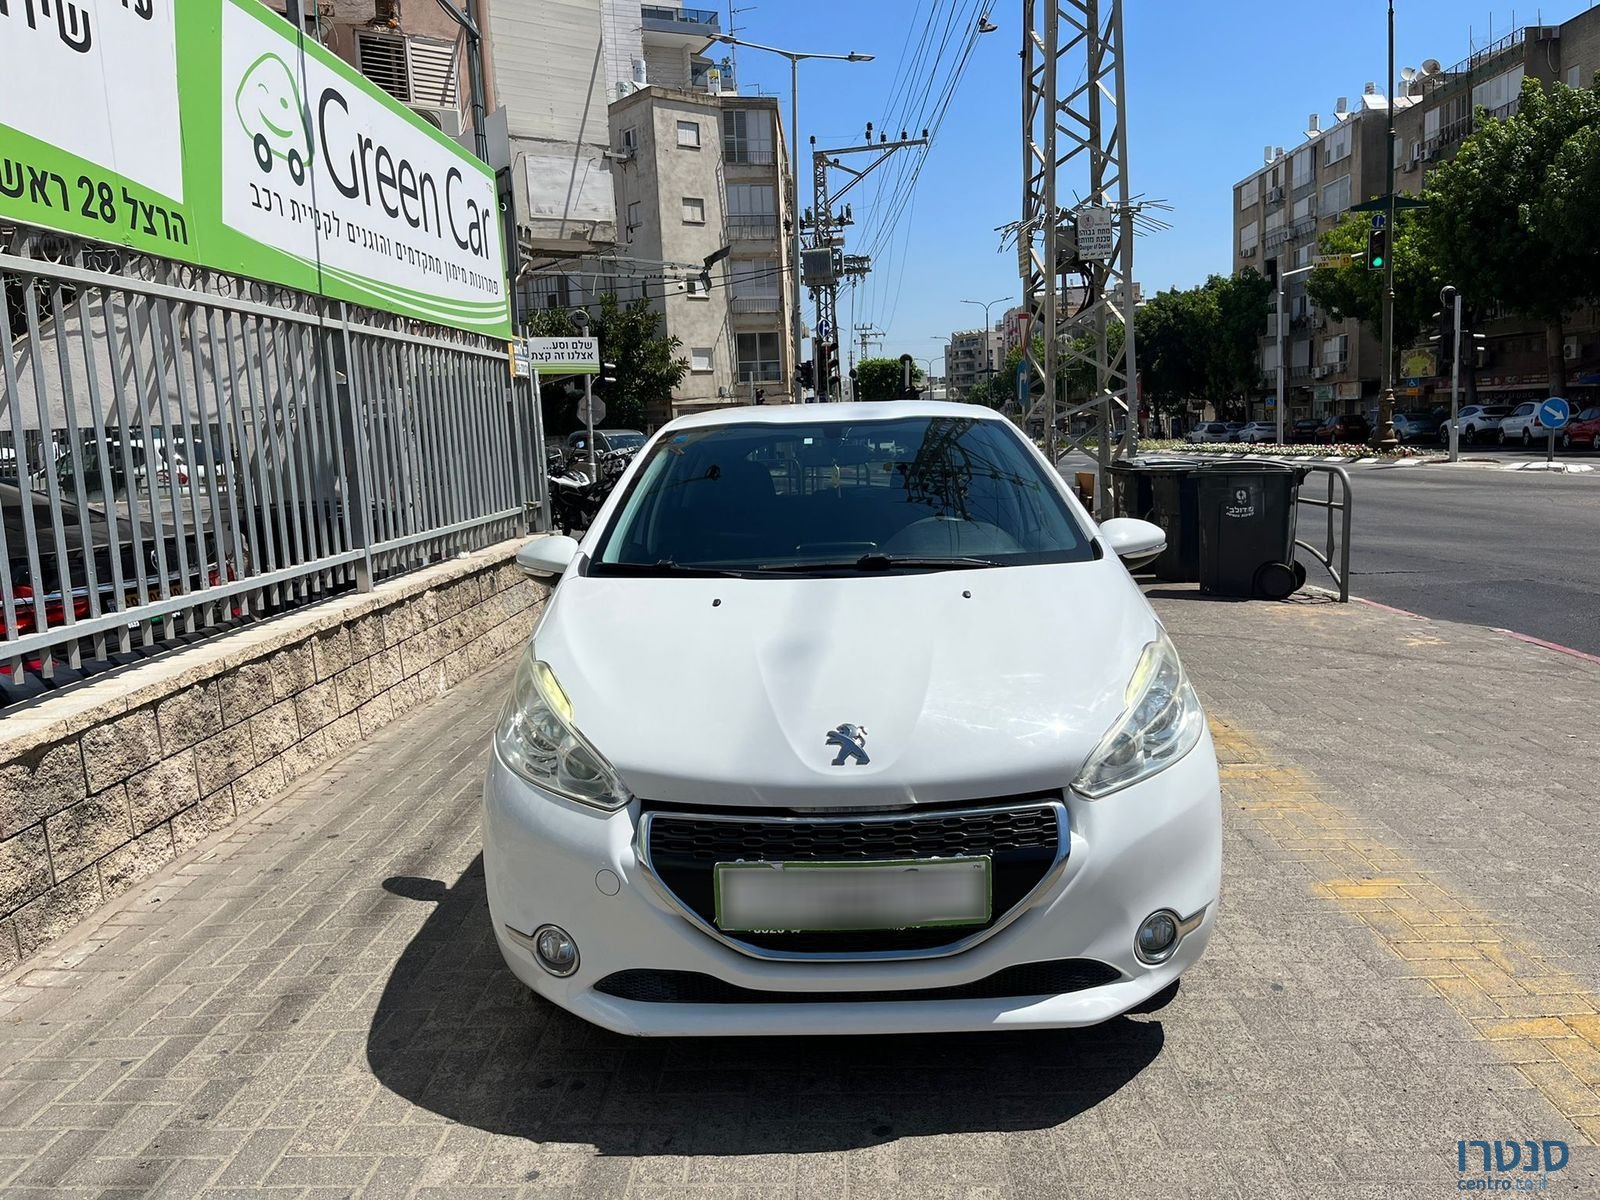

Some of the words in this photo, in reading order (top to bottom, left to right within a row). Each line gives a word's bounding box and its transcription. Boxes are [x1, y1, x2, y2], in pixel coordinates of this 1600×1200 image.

[318, 87, 441, 239] Green
[446, 167, 490, 260] Car
[77, 175, 117, 224] 28
[249, 182, 284, 217] רכב
[121, 186, 188, 245] הרצל
[289, 198, 340, 240] לקניית
[346, 222, 392, 257] והוגנים
[395, 241, 442, 275] מתקדמים
[444, 261, 467, 284] מימון
[469, 271, 499, 295] פתרונות
[531, 351, 551, 362] קצת
[543, 341, 569, 350] וסע...
[554, 351, 565, 360] זה
[567, 351, 594, 360] אצלנו
[571, 340, 593, 350] שלם
